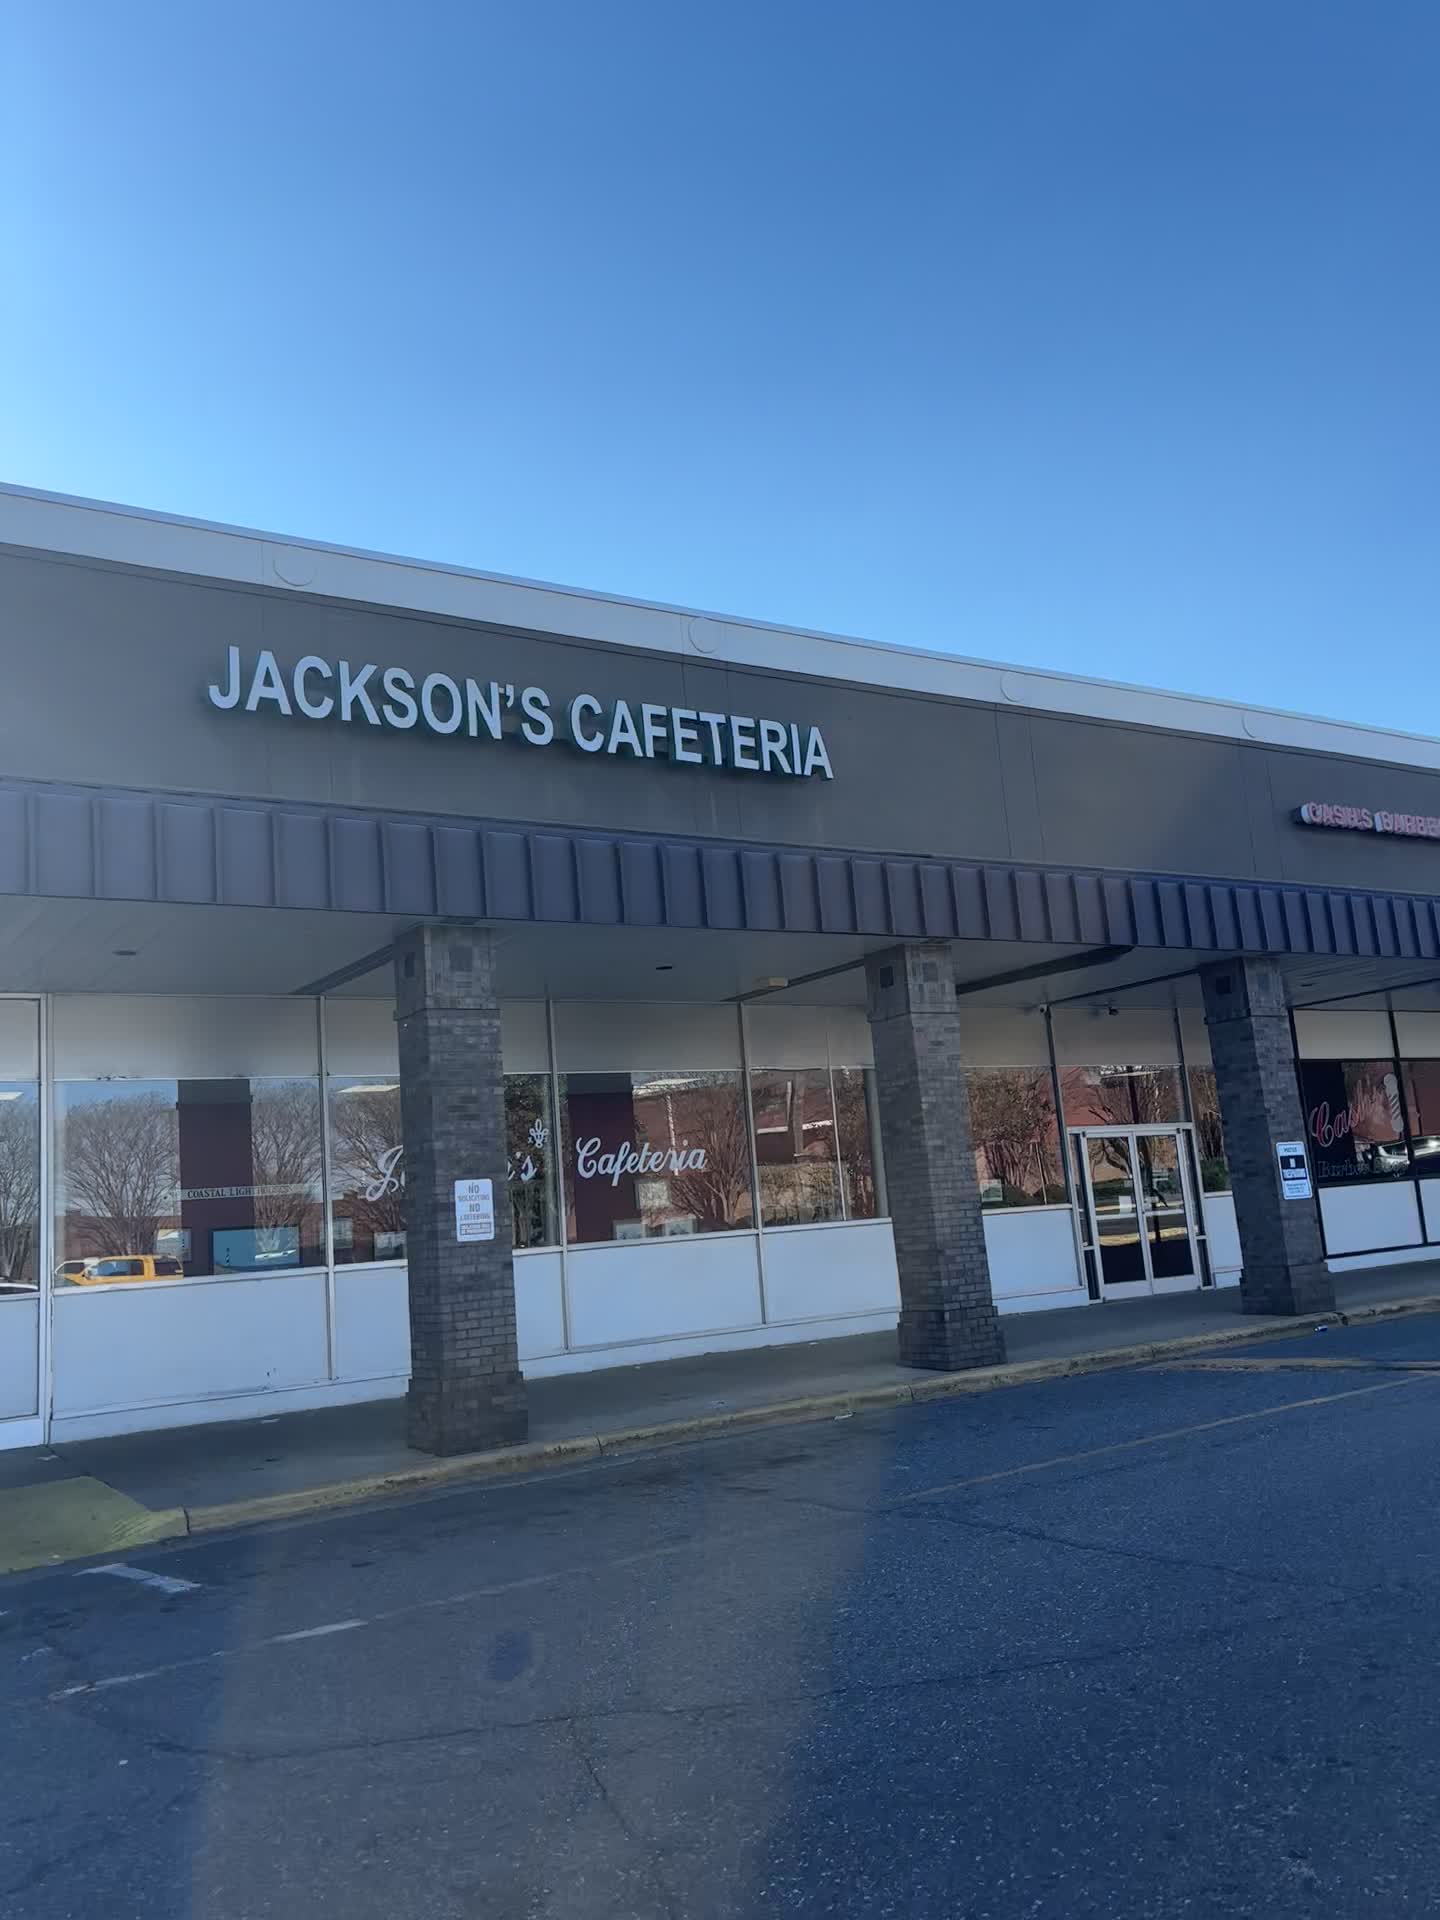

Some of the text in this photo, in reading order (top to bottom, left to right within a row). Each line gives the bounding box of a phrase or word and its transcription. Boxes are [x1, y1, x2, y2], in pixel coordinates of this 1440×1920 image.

[208, 645, 834, 780] JACKSON'S CAFETERIA
[575, 1137, 708, 1187] Cafeteria
[187, 1188, 225, 1199] COASTAL
[468, 1183, 480, 1193] NO
[469, 1202, 481, 1213] NO
